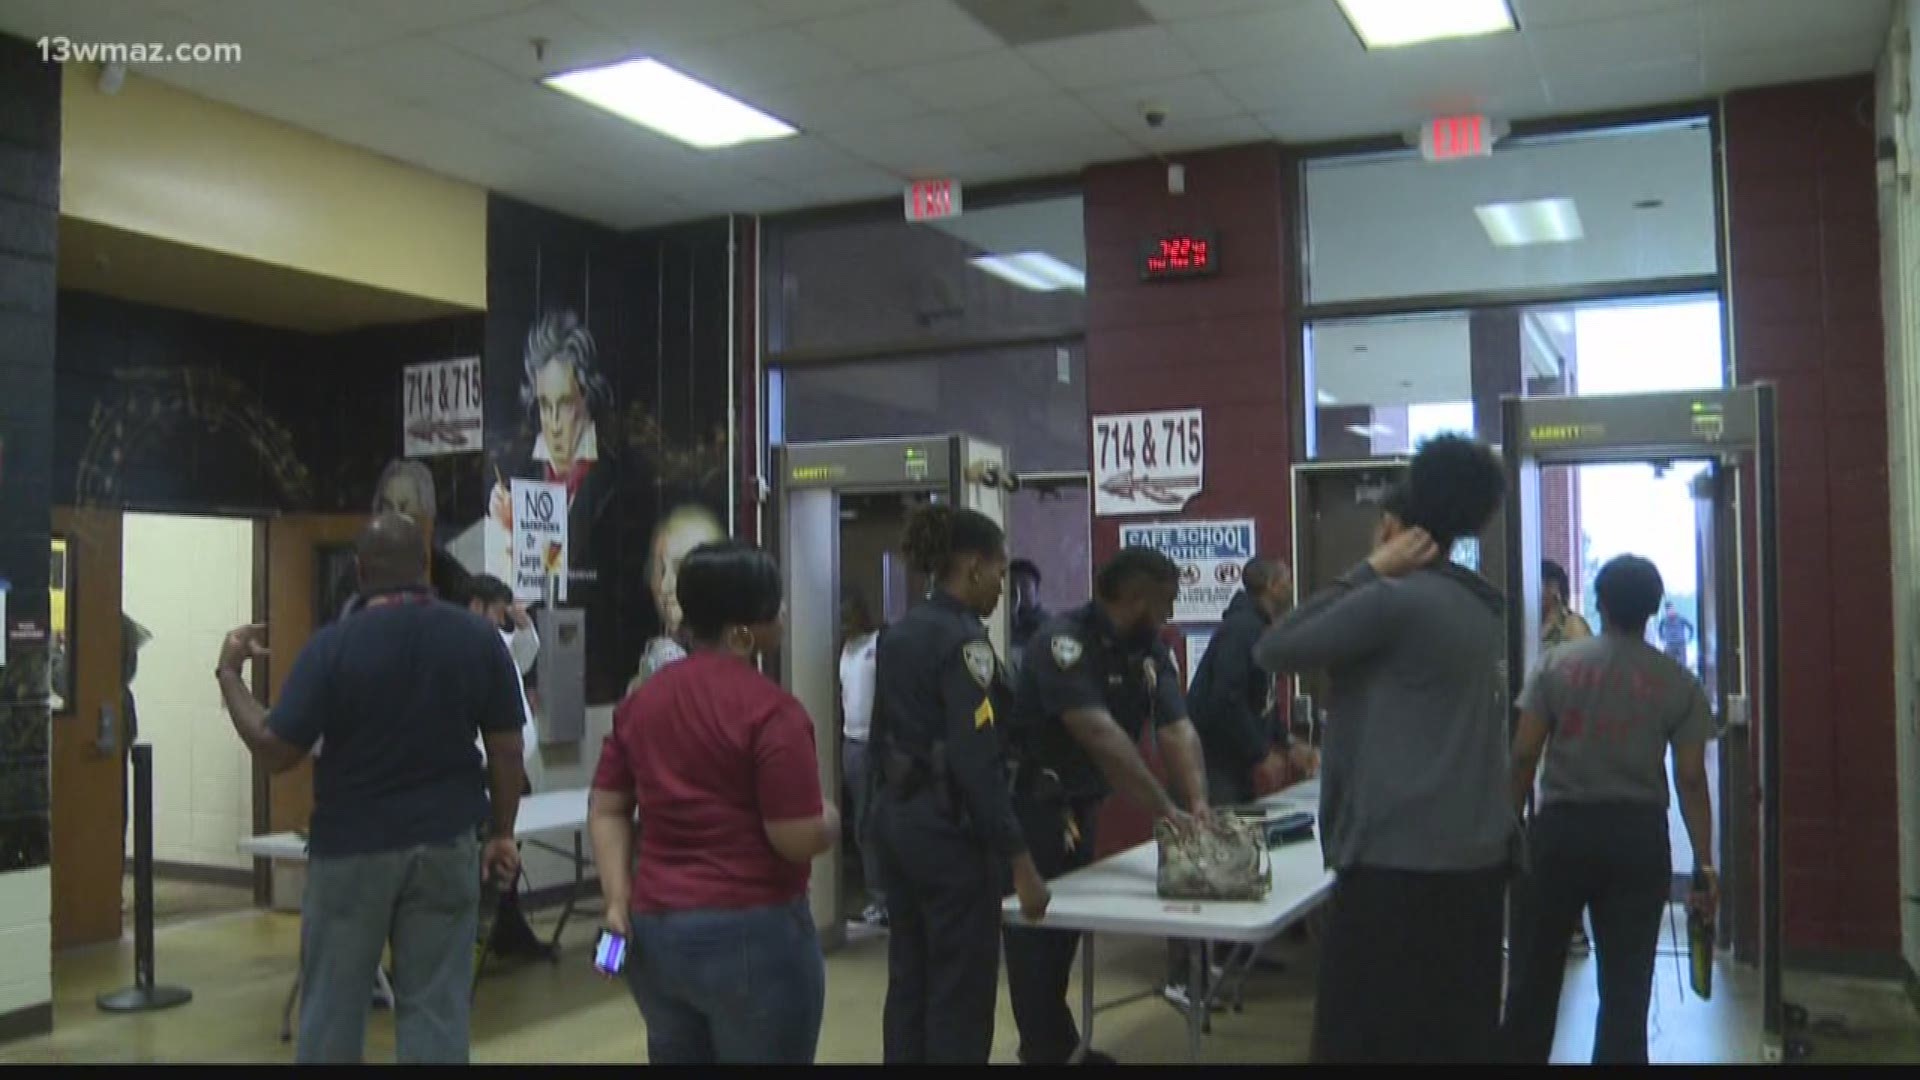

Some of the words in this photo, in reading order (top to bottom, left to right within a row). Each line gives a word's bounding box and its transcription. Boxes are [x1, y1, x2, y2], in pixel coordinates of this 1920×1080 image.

[1432, 116, 1481, 156] EXIT
[912, 181, 952, 218] EXIT
[406, 370, 433, 416] 714
[439, 366, 449, 412] &
[452, 362, 481, 409] 715
[1097, 421, 1135, 469] 714
[1142, 418, 1157, 468] &
[1162, 417, 1200, 467] 715
[526, 489, 554, 522] NO
[1177, 526, 1248, 556] SCHOOL
